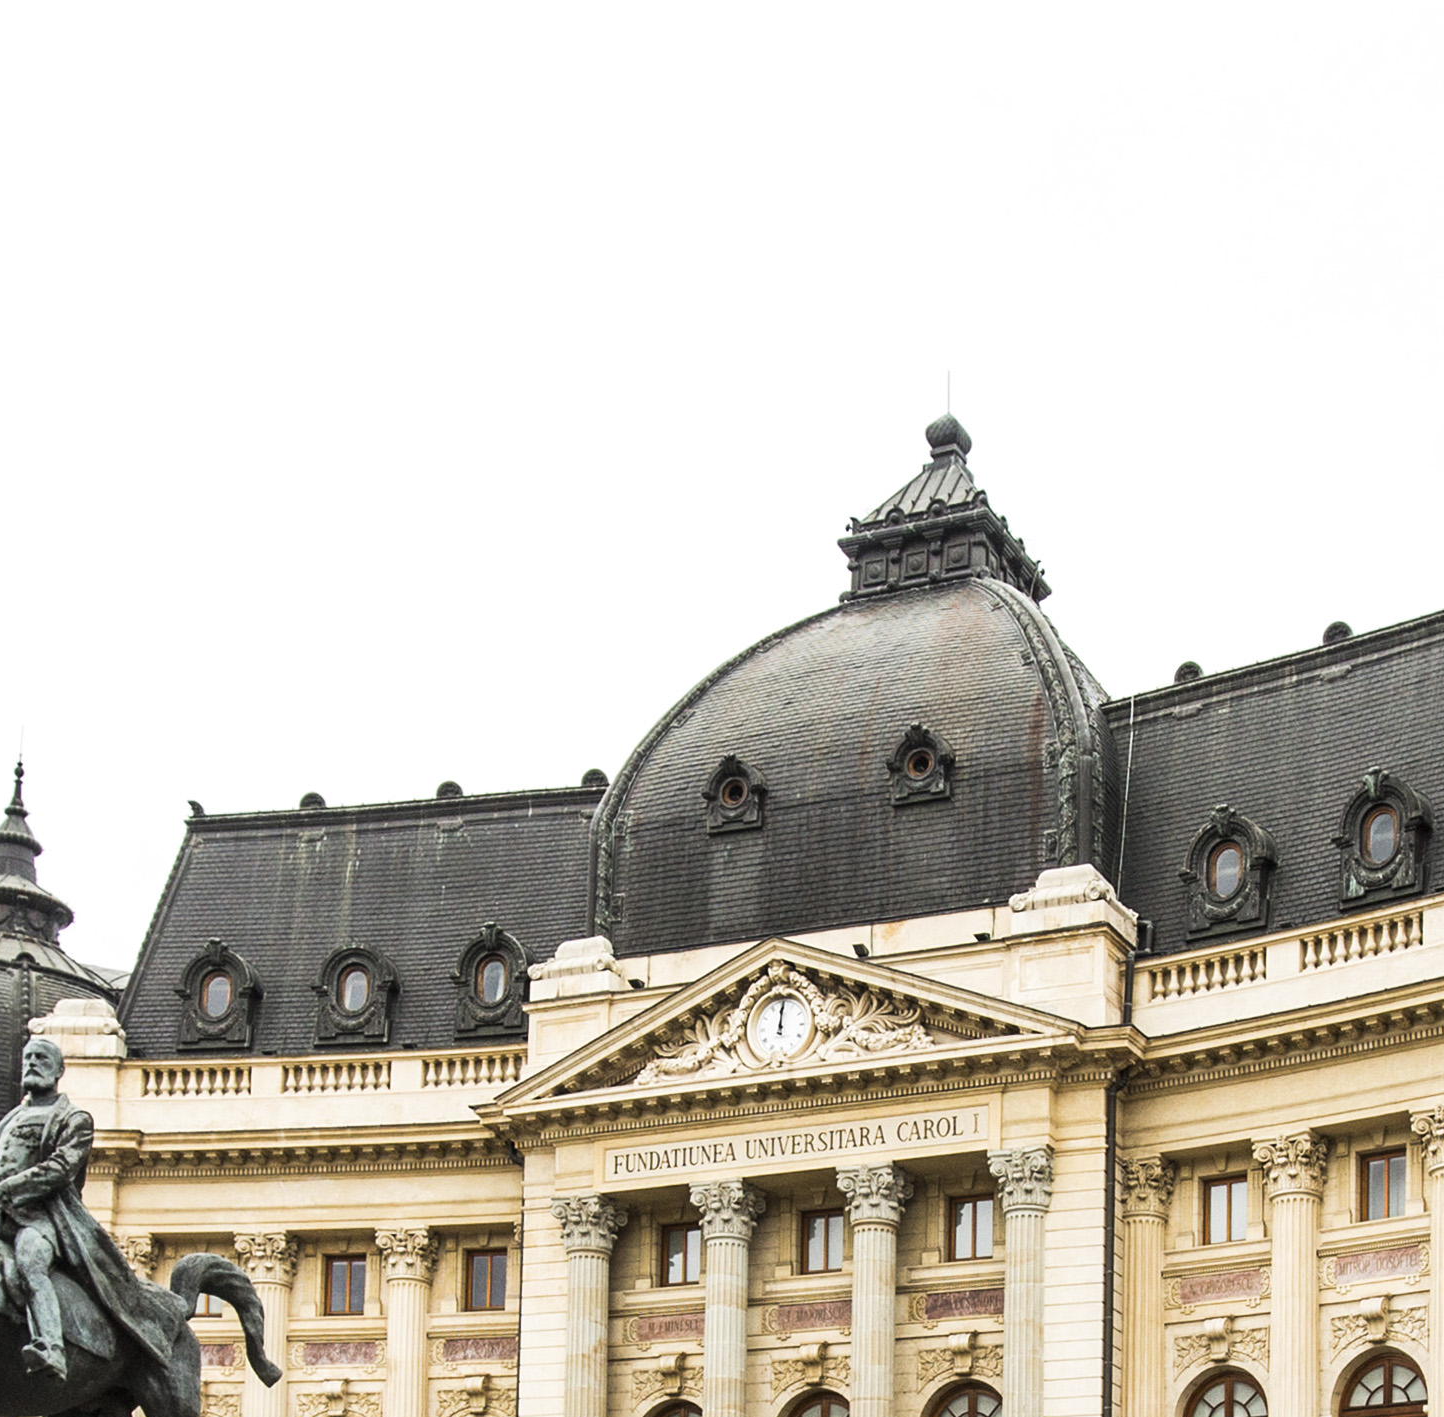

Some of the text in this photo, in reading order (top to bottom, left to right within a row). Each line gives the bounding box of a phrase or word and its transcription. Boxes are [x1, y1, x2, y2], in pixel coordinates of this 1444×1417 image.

[613, 1112, 980, 1175] FUNDATIUNEA UNIVERSITARA CAROL I
